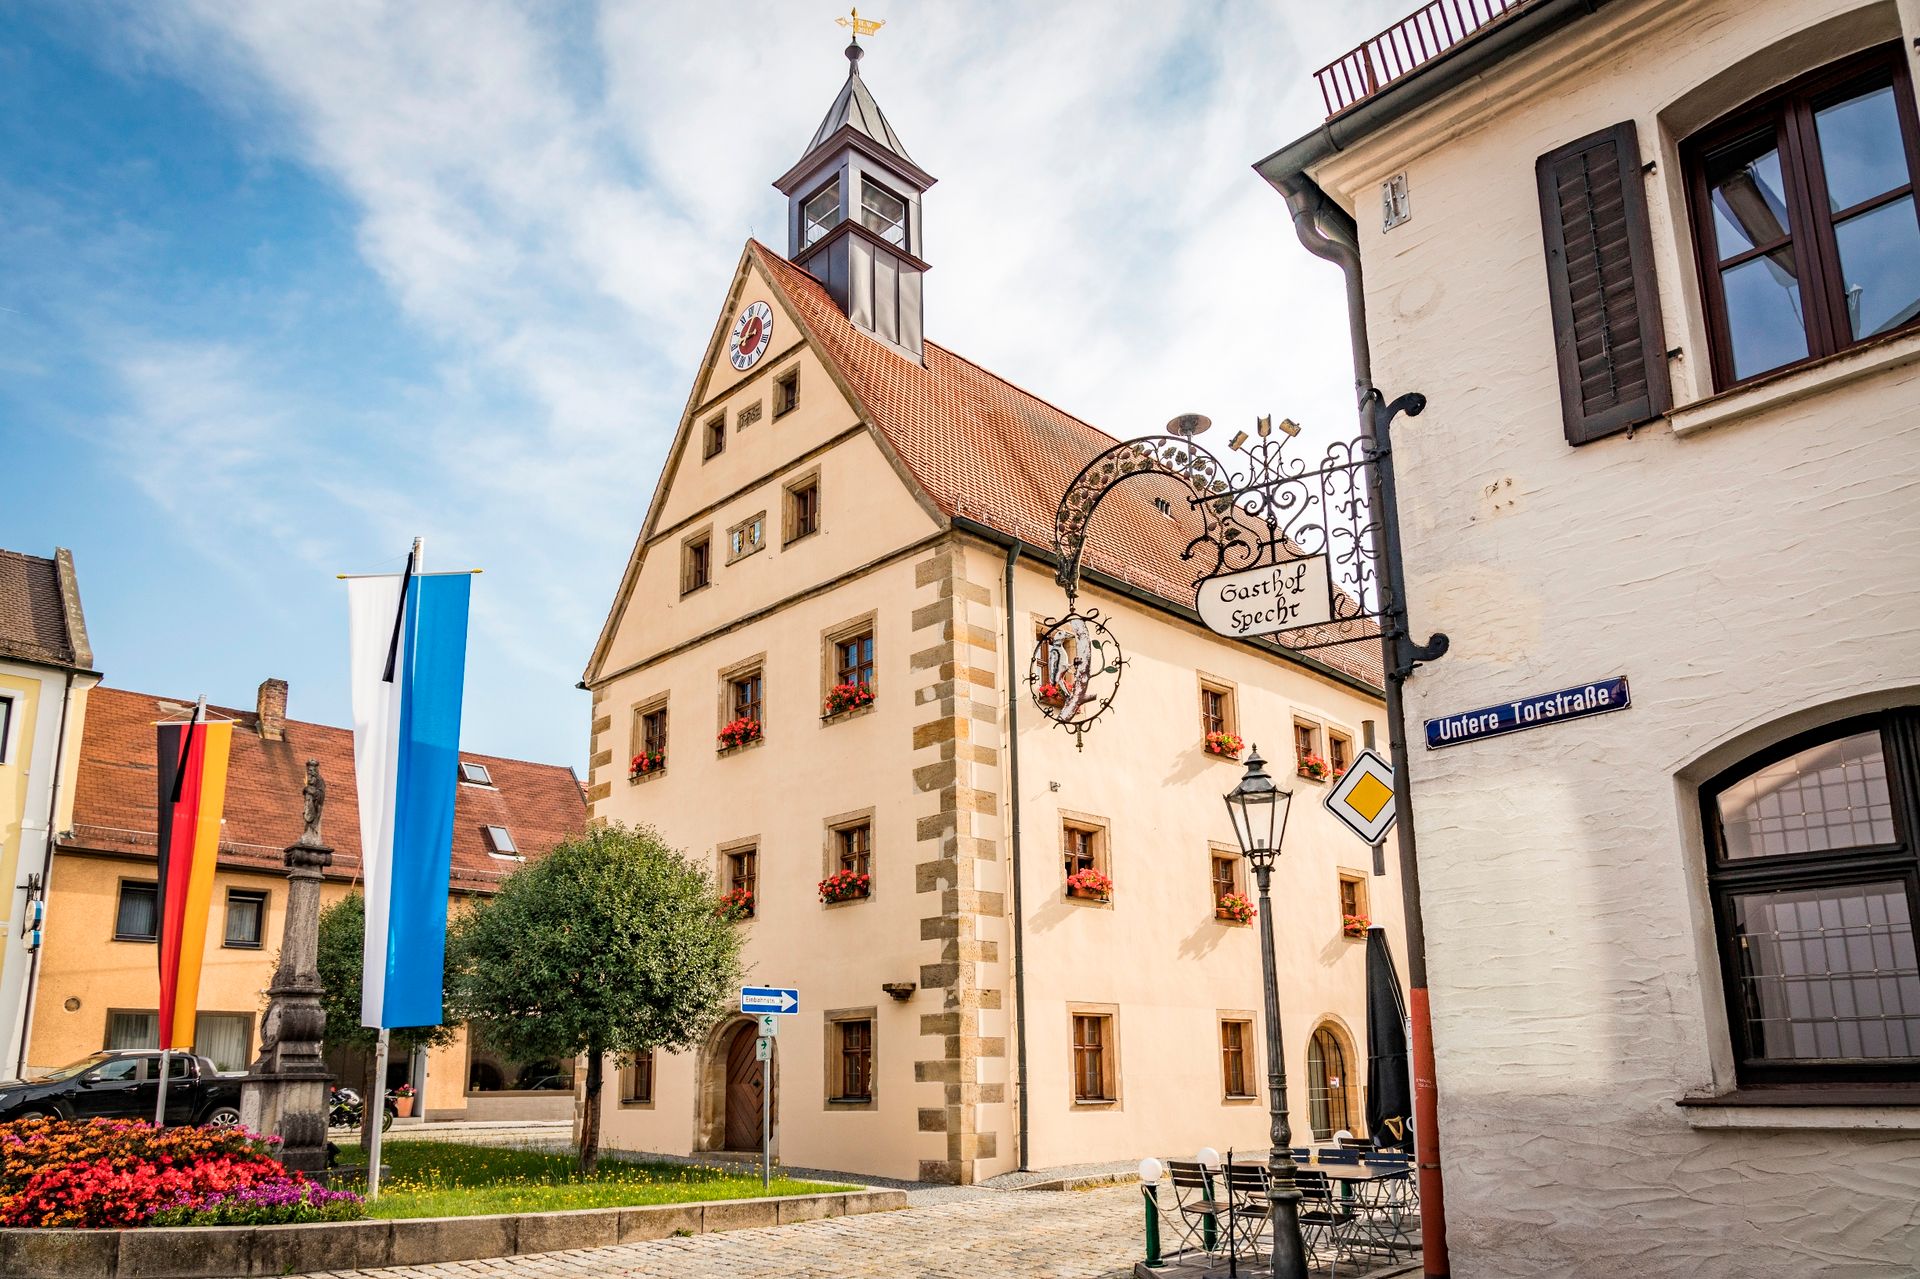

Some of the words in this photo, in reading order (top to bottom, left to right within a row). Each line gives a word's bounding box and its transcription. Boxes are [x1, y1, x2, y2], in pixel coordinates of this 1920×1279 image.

[1220, 563, 1307, 602] Gasthof
[1231, 596, 1301, 634] Specht
[1439, 712, 1499, 740] Untere
[1511, 686, 1609, 724] Torstraße
